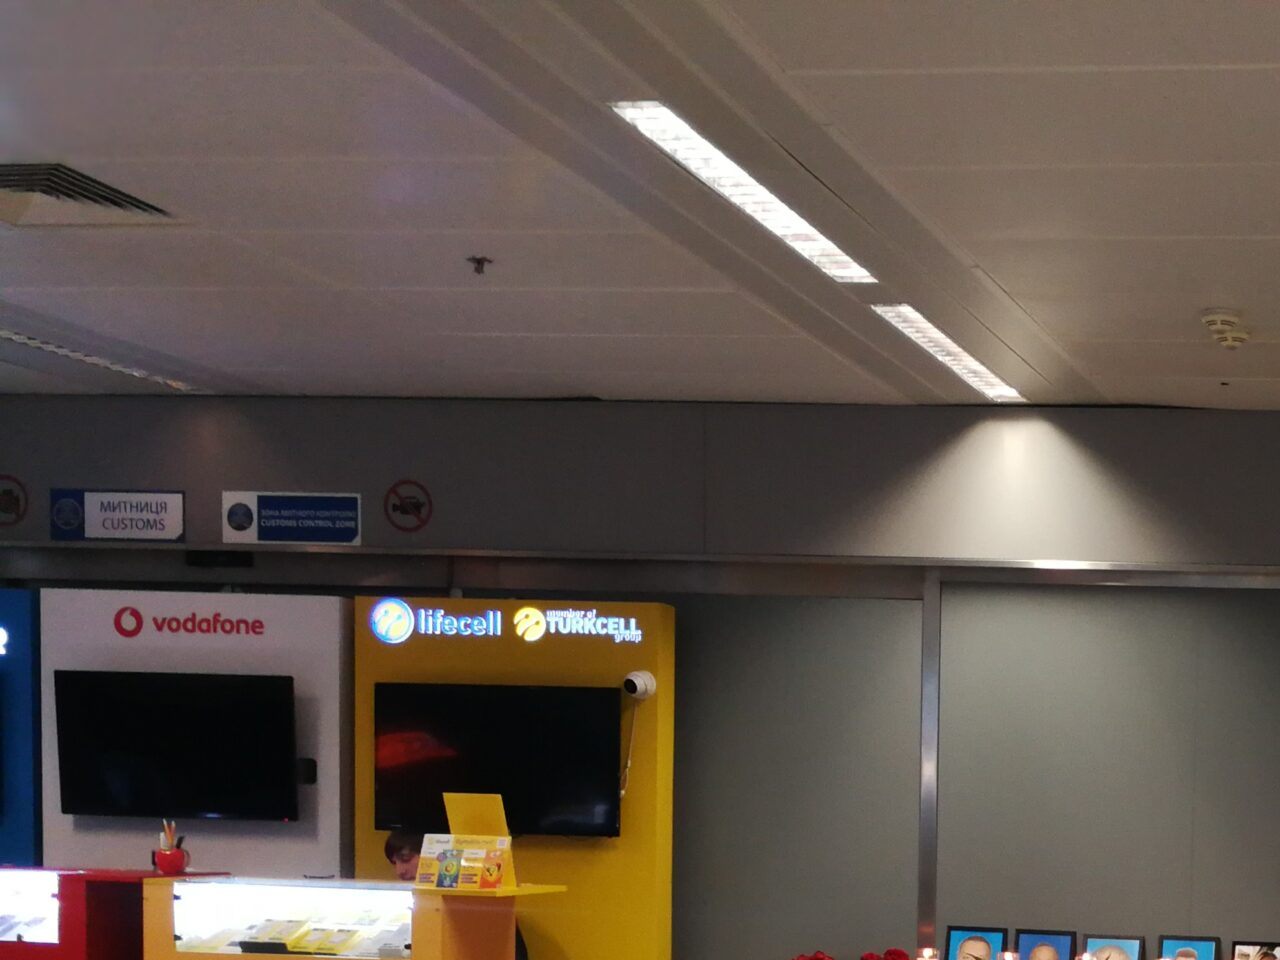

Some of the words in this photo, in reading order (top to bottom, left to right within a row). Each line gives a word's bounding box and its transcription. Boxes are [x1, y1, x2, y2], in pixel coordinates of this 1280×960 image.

[99, 501, 168, 515] МИТНИЦЯ
[102, 518, 166, 531] CUSTOMS
[261, 519, 297, 527] CUSTOMS
[298, 519, 334, 528] CONTROL
[335, 520, 356, 529] ZONE
[547, 609, 585, 619] member
[586, 609, 597, 619] of
[152, 612, 264, 635] vodafone
[417, 608, 503, 636] lifecell
[547, 617, 642, 636] TURKCELL
[614, 632, 642, 643] group
